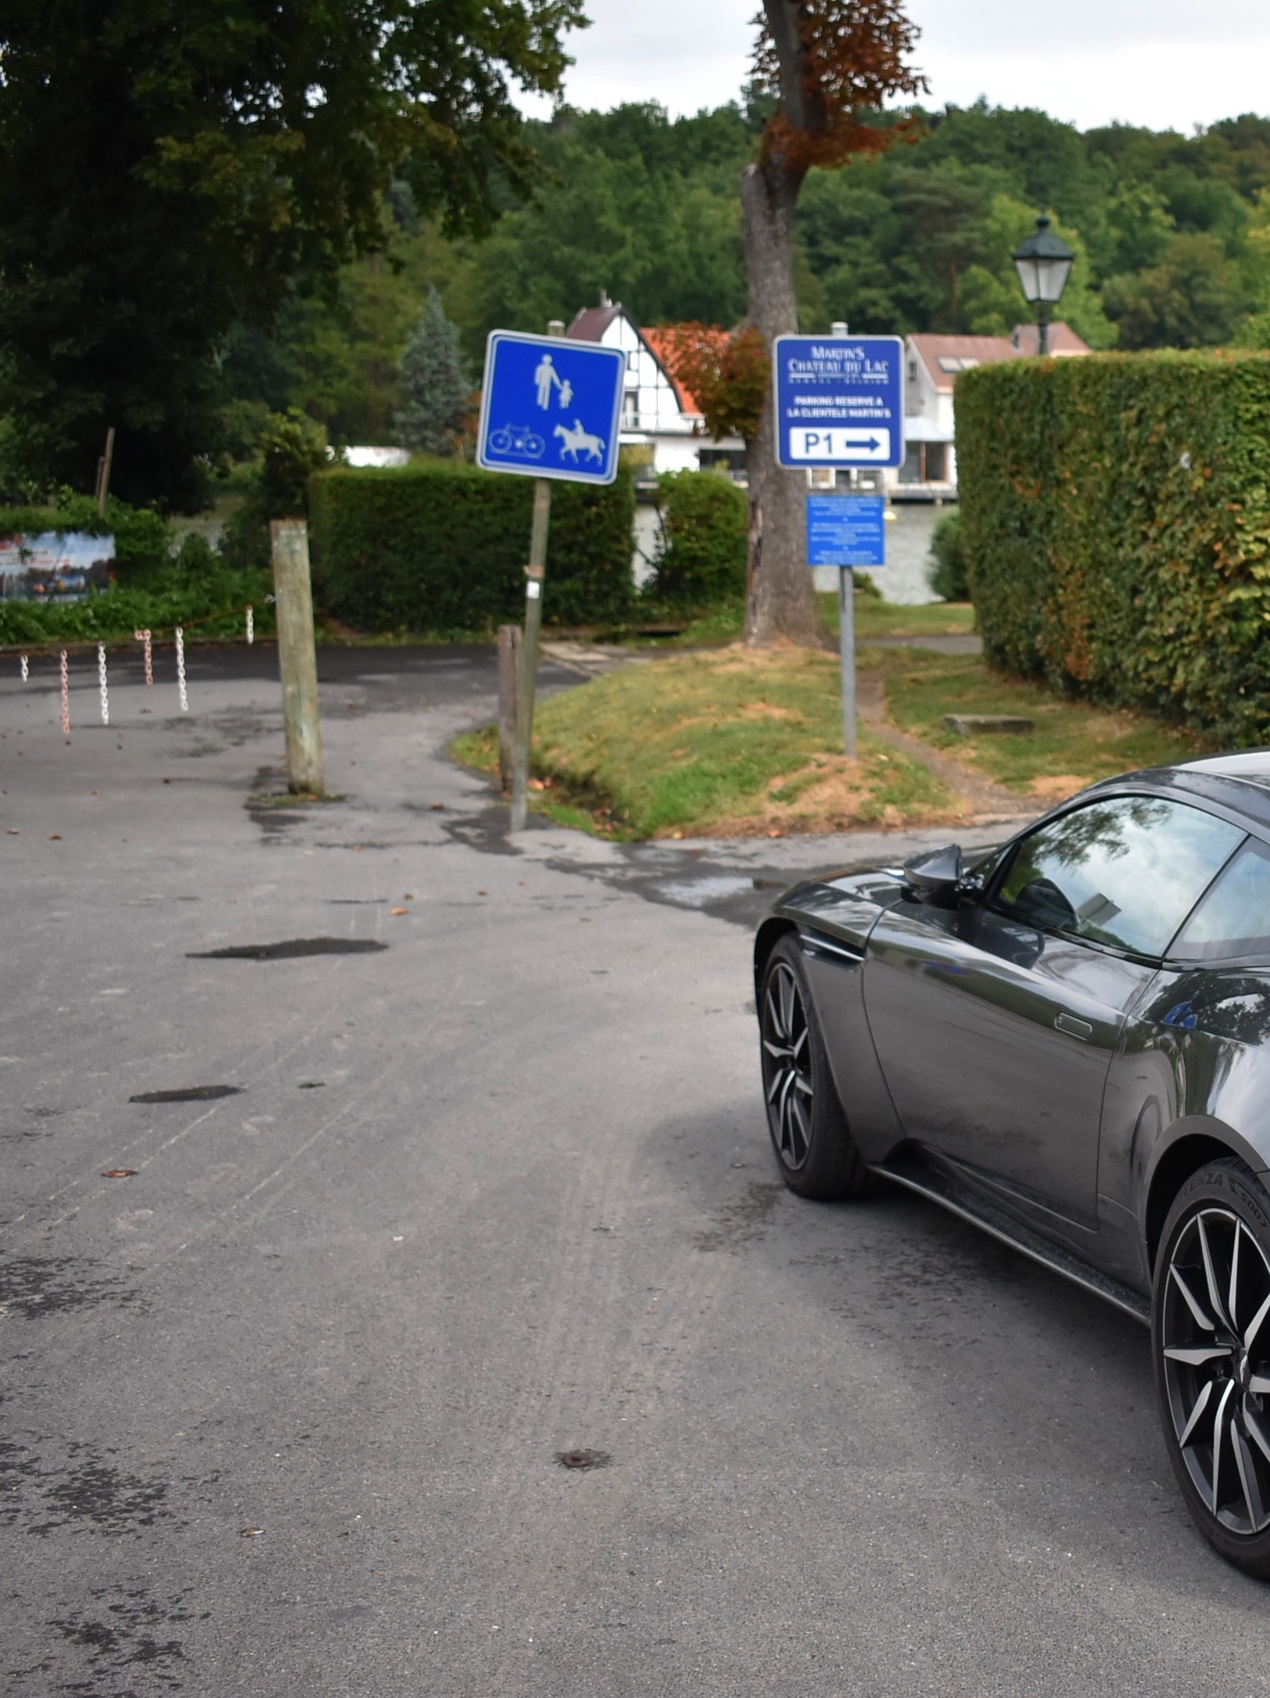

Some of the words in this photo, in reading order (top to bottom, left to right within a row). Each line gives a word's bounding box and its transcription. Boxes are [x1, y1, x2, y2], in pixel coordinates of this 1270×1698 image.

[844, 360, 861, 373] DU
[864, 359, 889, 373] LAC
[794, 395, 834, 406] PARKING
[787, 407, 800, 418] LA
[805, 432, 832, 454] P1
